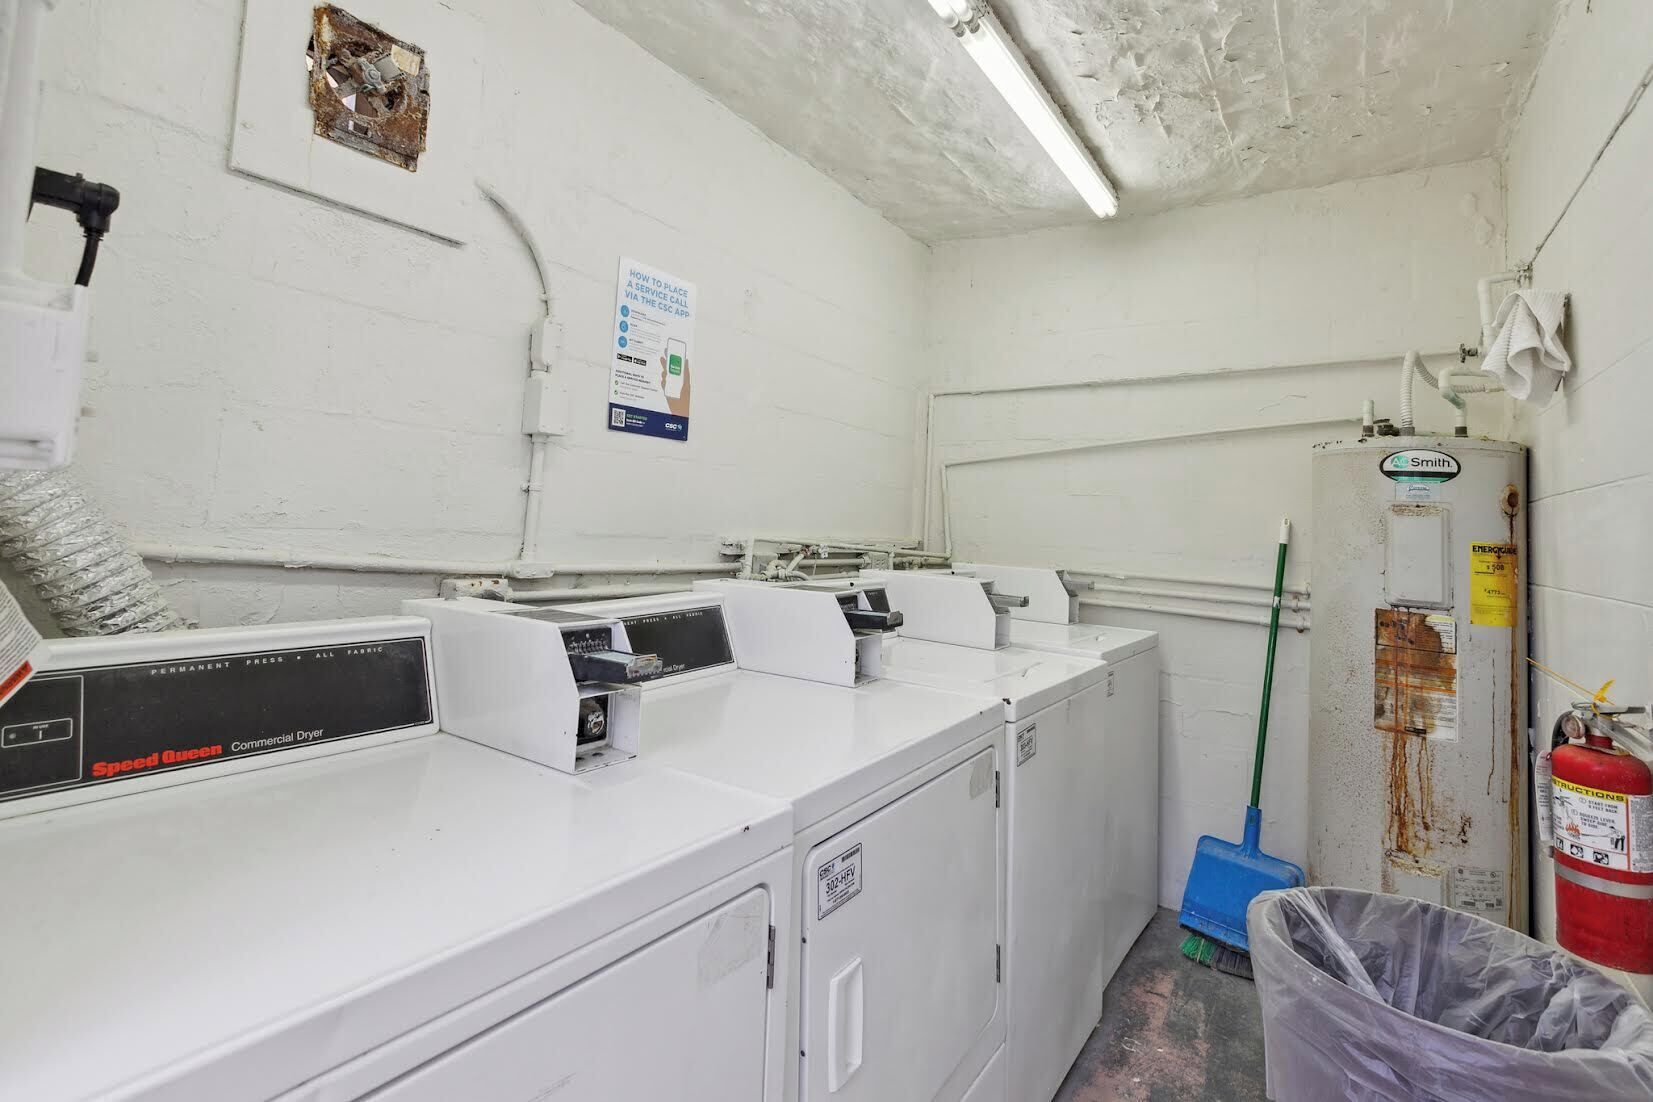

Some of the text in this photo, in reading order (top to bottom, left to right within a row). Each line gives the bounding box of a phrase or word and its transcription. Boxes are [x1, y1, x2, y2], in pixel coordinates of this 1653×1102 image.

[627, 280, 689, 309] A SERVICE CALL
[630, 269, 688, 298] HOW TO PLACE
[624, 290, 639, 302] VIA
[641, 296, 657, 308] THE
[658, 302, 673, 314] CSC
[675, 308, 690, 318] APP
[665, 422, 677, 430] CSC
[1411, 457, 1450, 468] Smith
[151, 646, 384, 675] PERMANENT PRESS ALL FABRIC
[92, 728, 324, 778] Speed Queen Commercial Dryer
[1552, 778, 1624, 801] STRUCTIONS
[826, 865, 856, 894] 302-HFV
